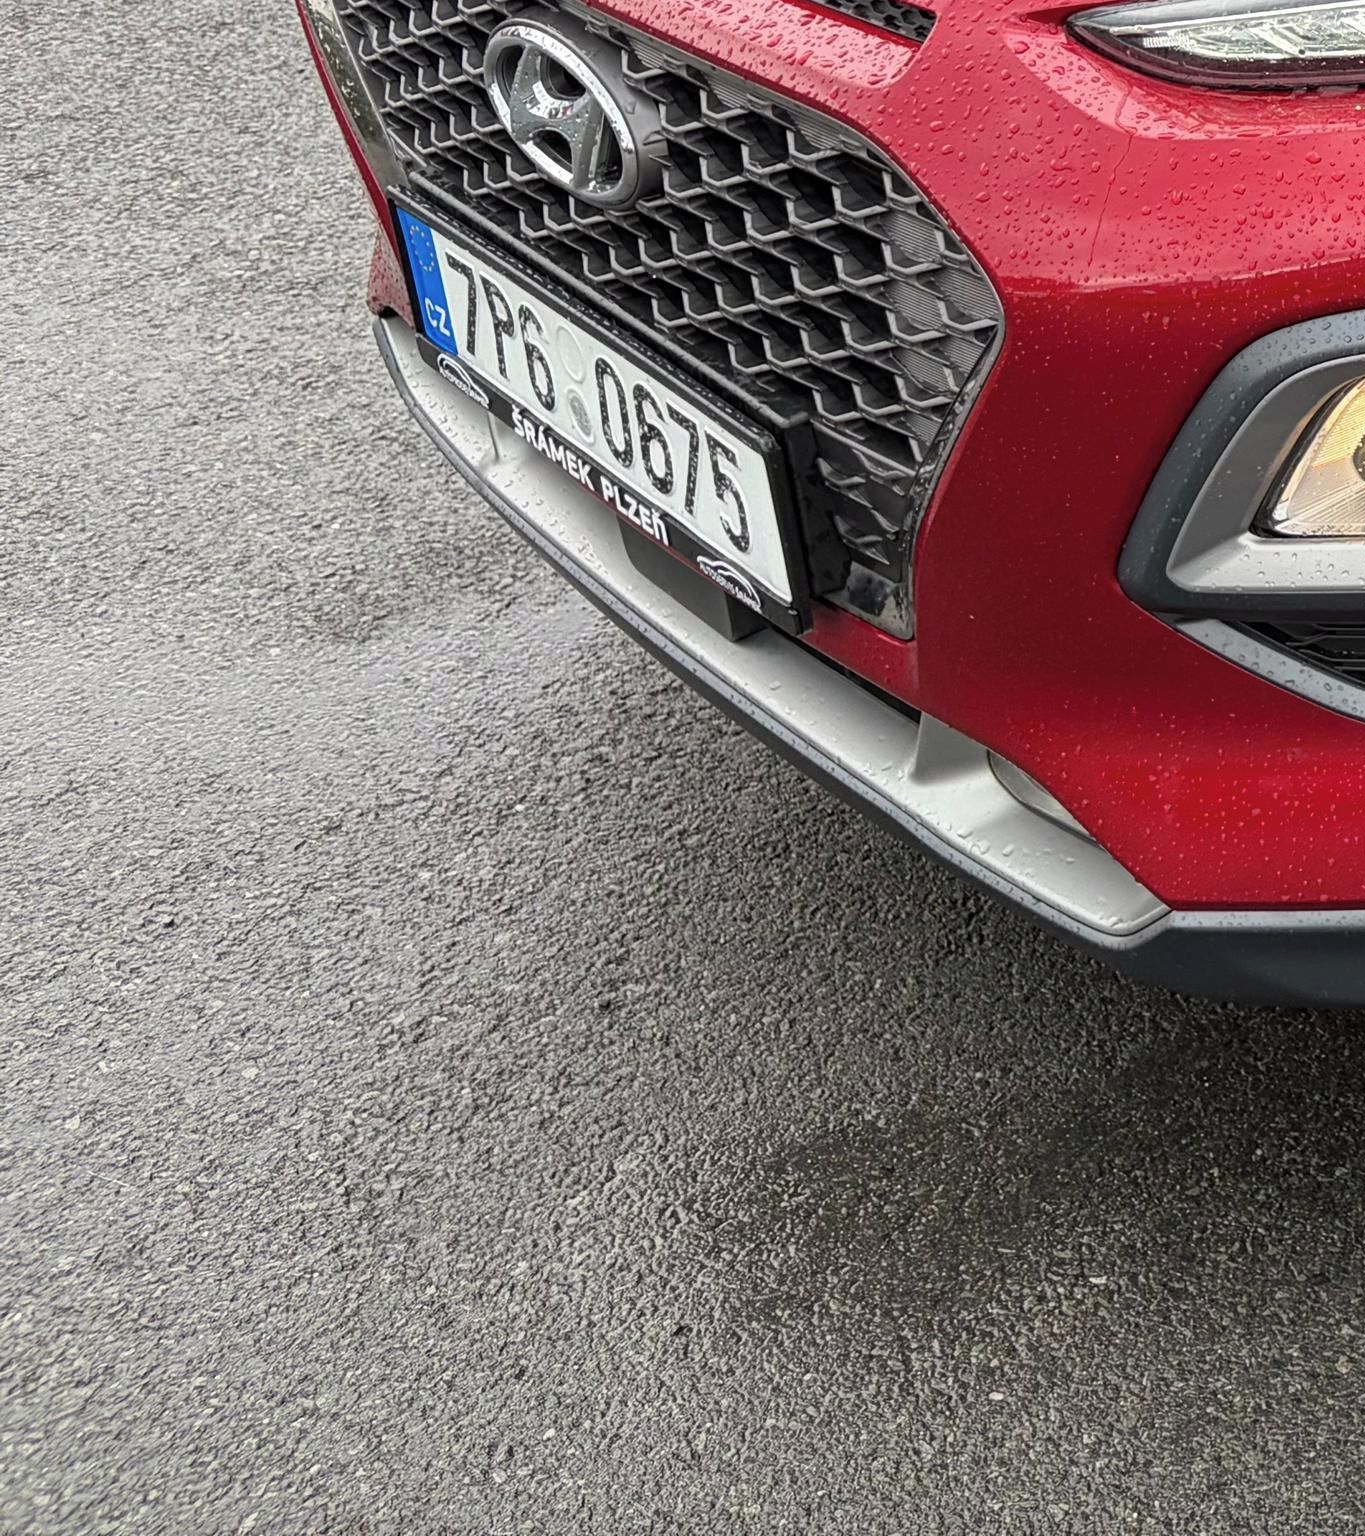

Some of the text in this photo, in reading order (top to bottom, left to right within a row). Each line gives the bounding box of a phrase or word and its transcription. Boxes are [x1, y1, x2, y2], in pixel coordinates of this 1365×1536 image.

[424, 296, 451, 337] CZ
[445, 251, 751, 553] 7P6 0675
[511, 404, 596, 492] ŠRÁMEK
